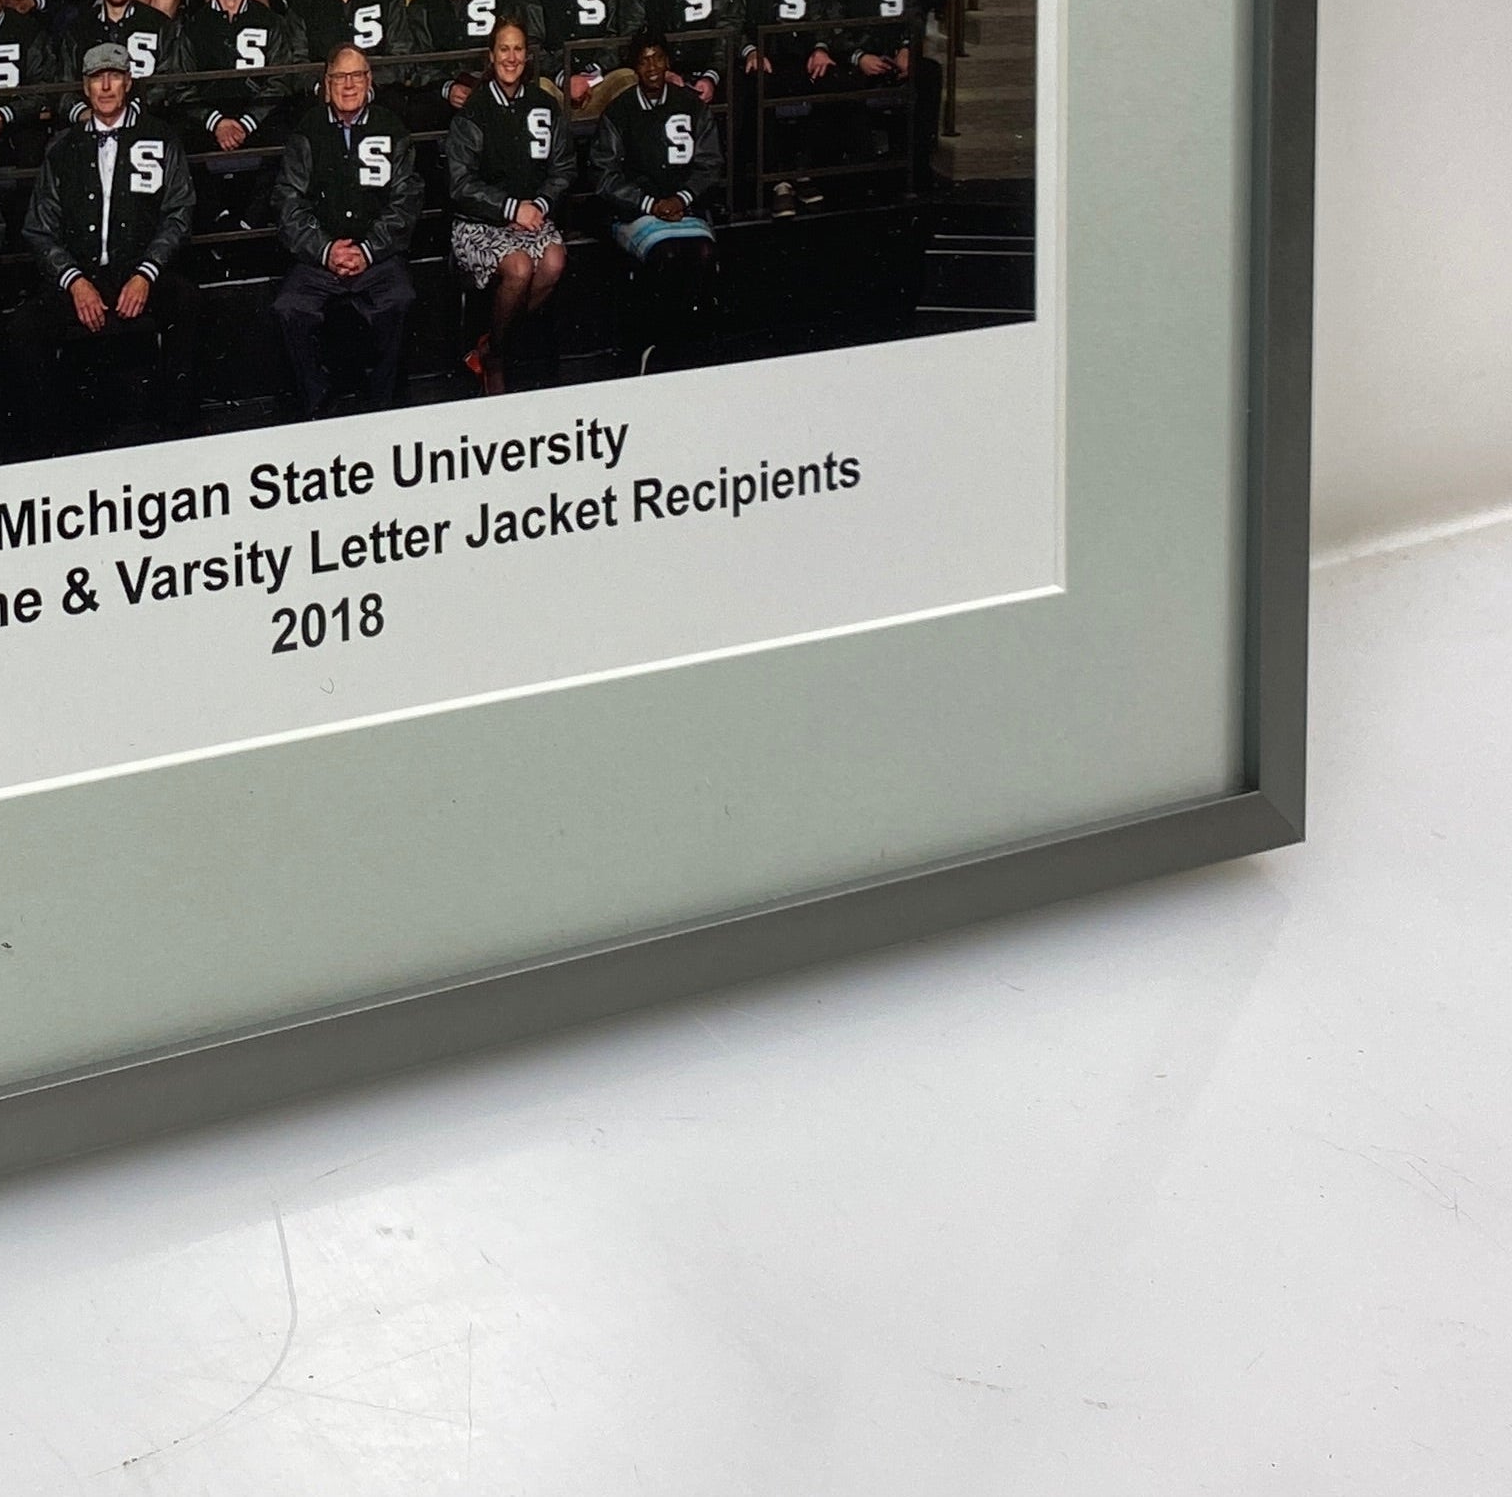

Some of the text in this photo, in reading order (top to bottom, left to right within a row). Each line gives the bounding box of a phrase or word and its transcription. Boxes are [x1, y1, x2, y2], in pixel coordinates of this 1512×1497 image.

[236, 28, 267, 69] S
[354, 5, 382, 48] S
[127, 32, 157, 78] S
[527, 109, 551, 158] S
[665, 114, 693, 163] S
[130, 141, 163, 193] S
[359, 136, 391, 186] S
[249, 454, 374, 510] State
[392, 418, 629, 488] University
[62, 567, 100, 615] &
[115, 540, 293, 605] Varsity
[310, 514, 451, 575] Letter
[465, 485, 618, 549] Jacket
[633, 452, 861, 523] Recipients
[271, 592, 384, 654] 2018
